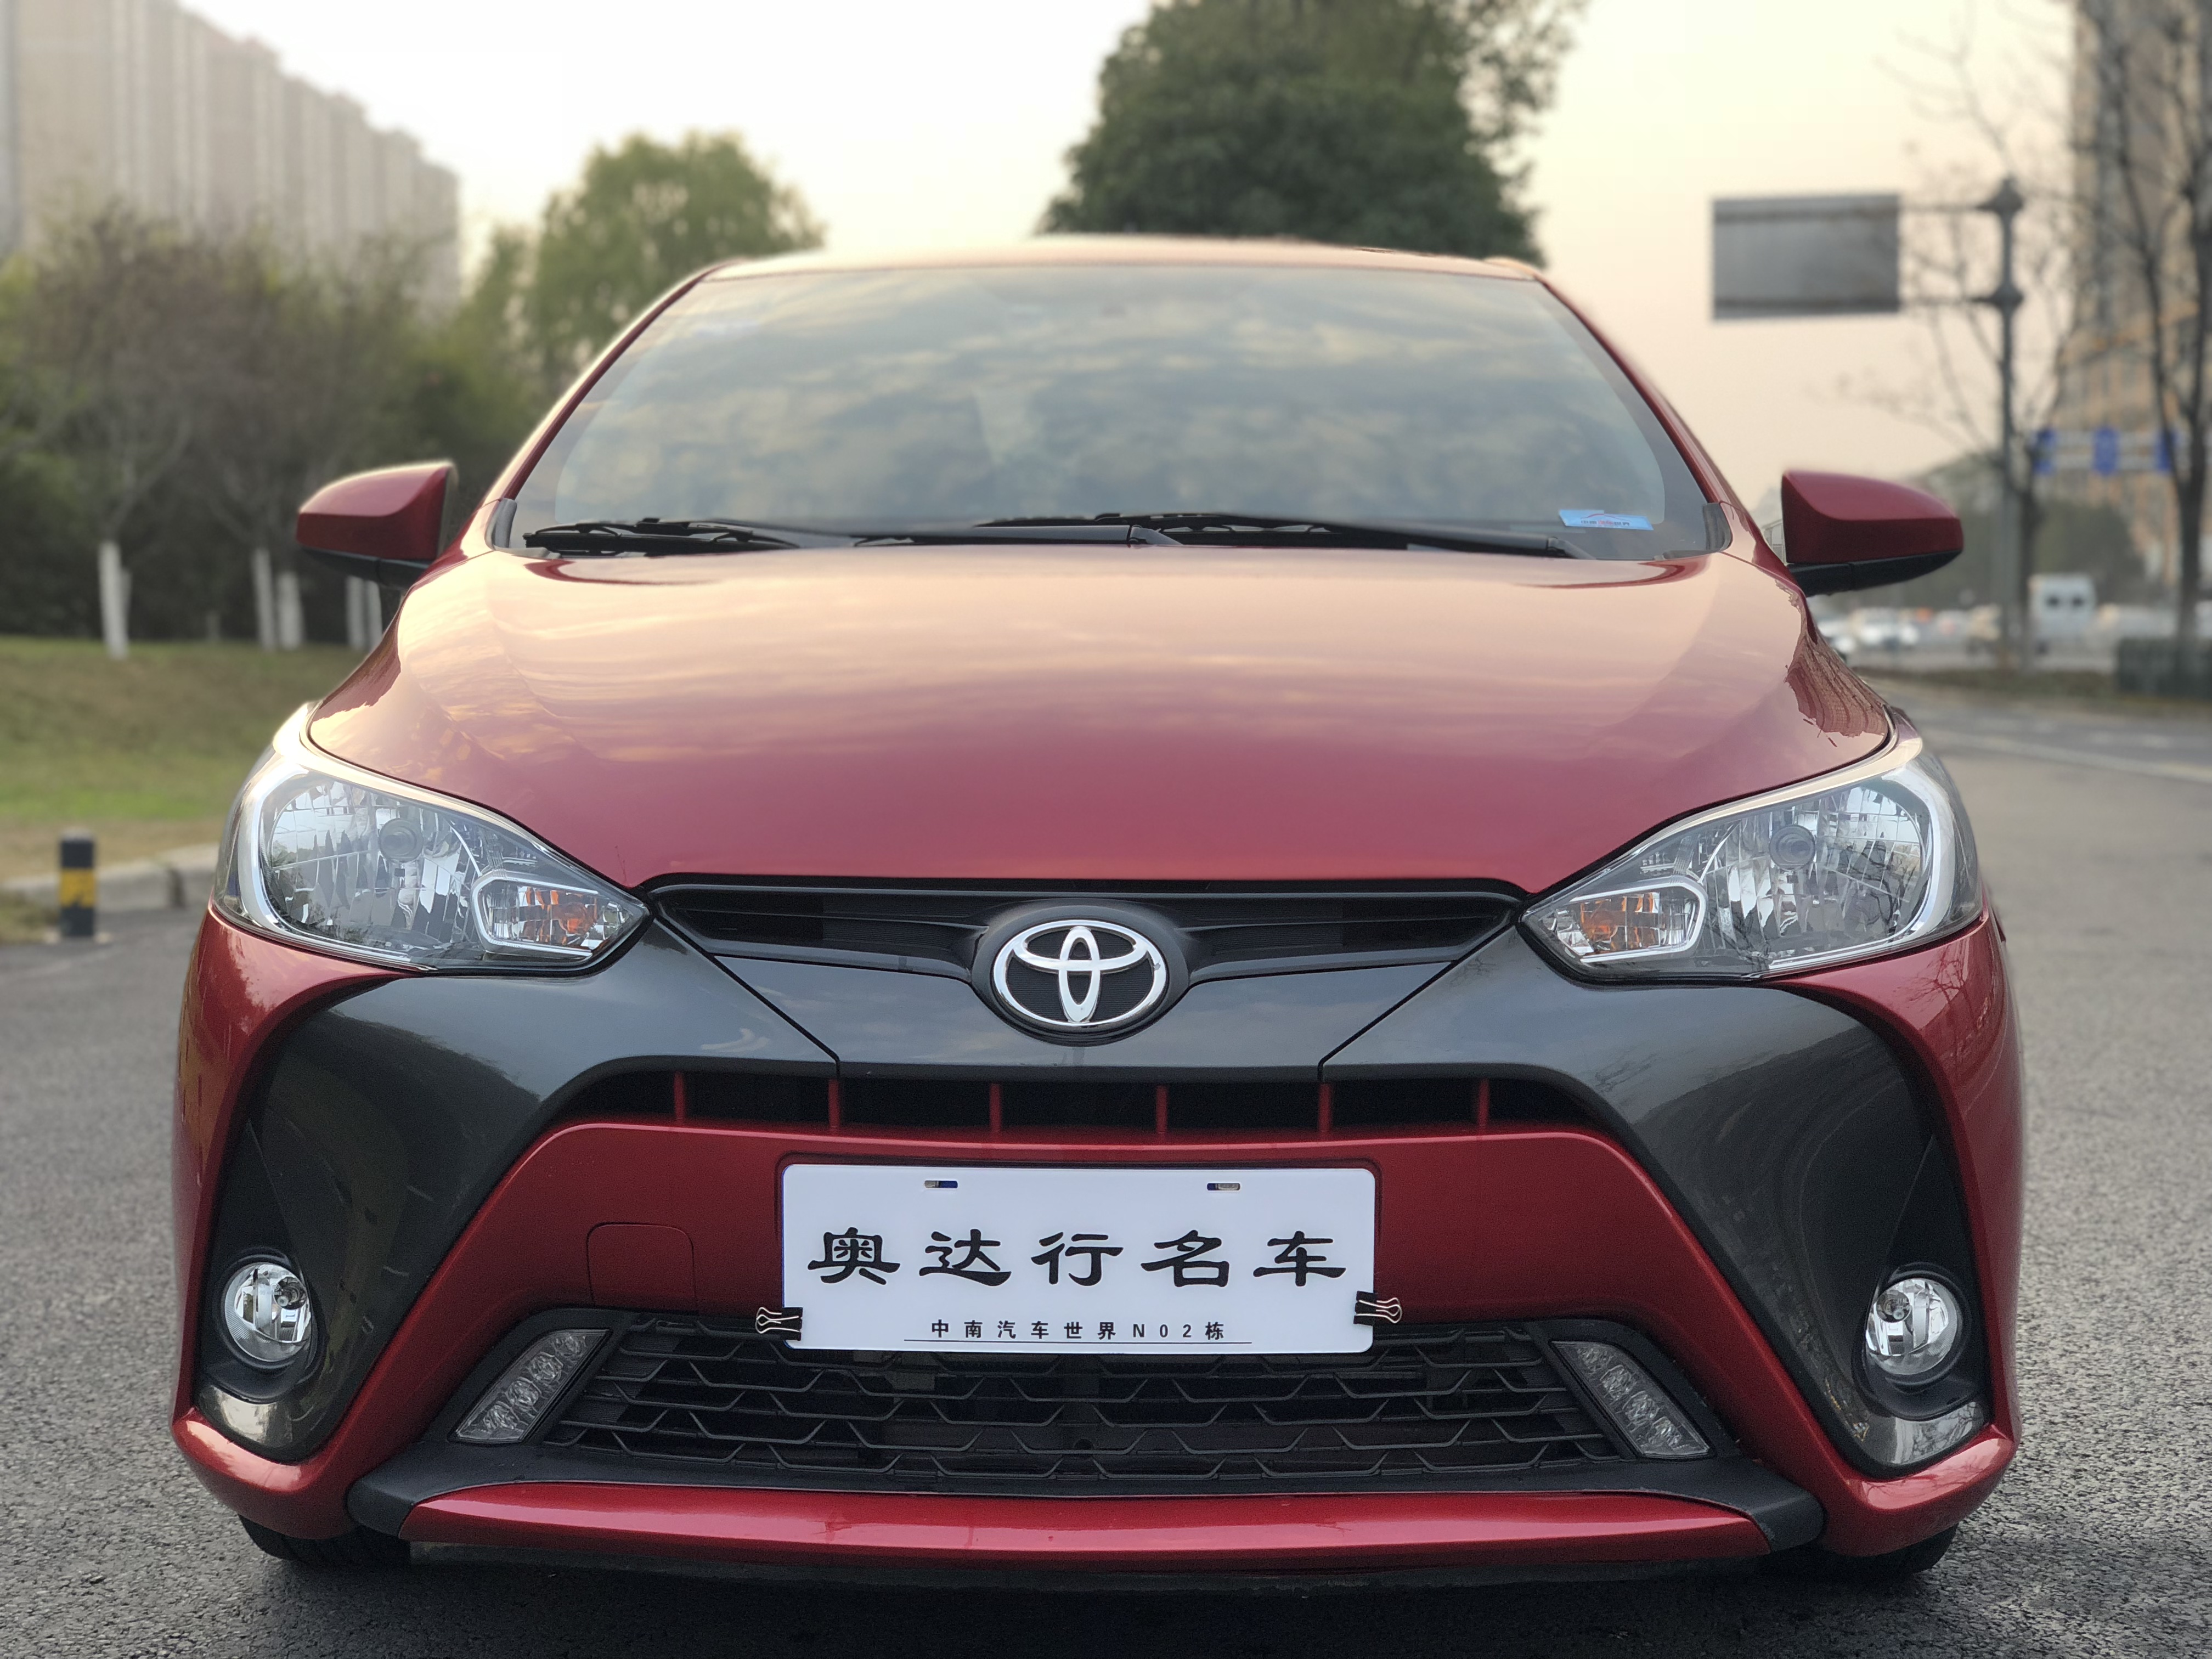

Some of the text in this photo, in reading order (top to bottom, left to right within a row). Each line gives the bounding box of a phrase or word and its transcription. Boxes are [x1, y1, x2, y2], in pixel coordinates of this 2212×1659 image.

[806, 1226, 1347, 1288] 奥达行名车
